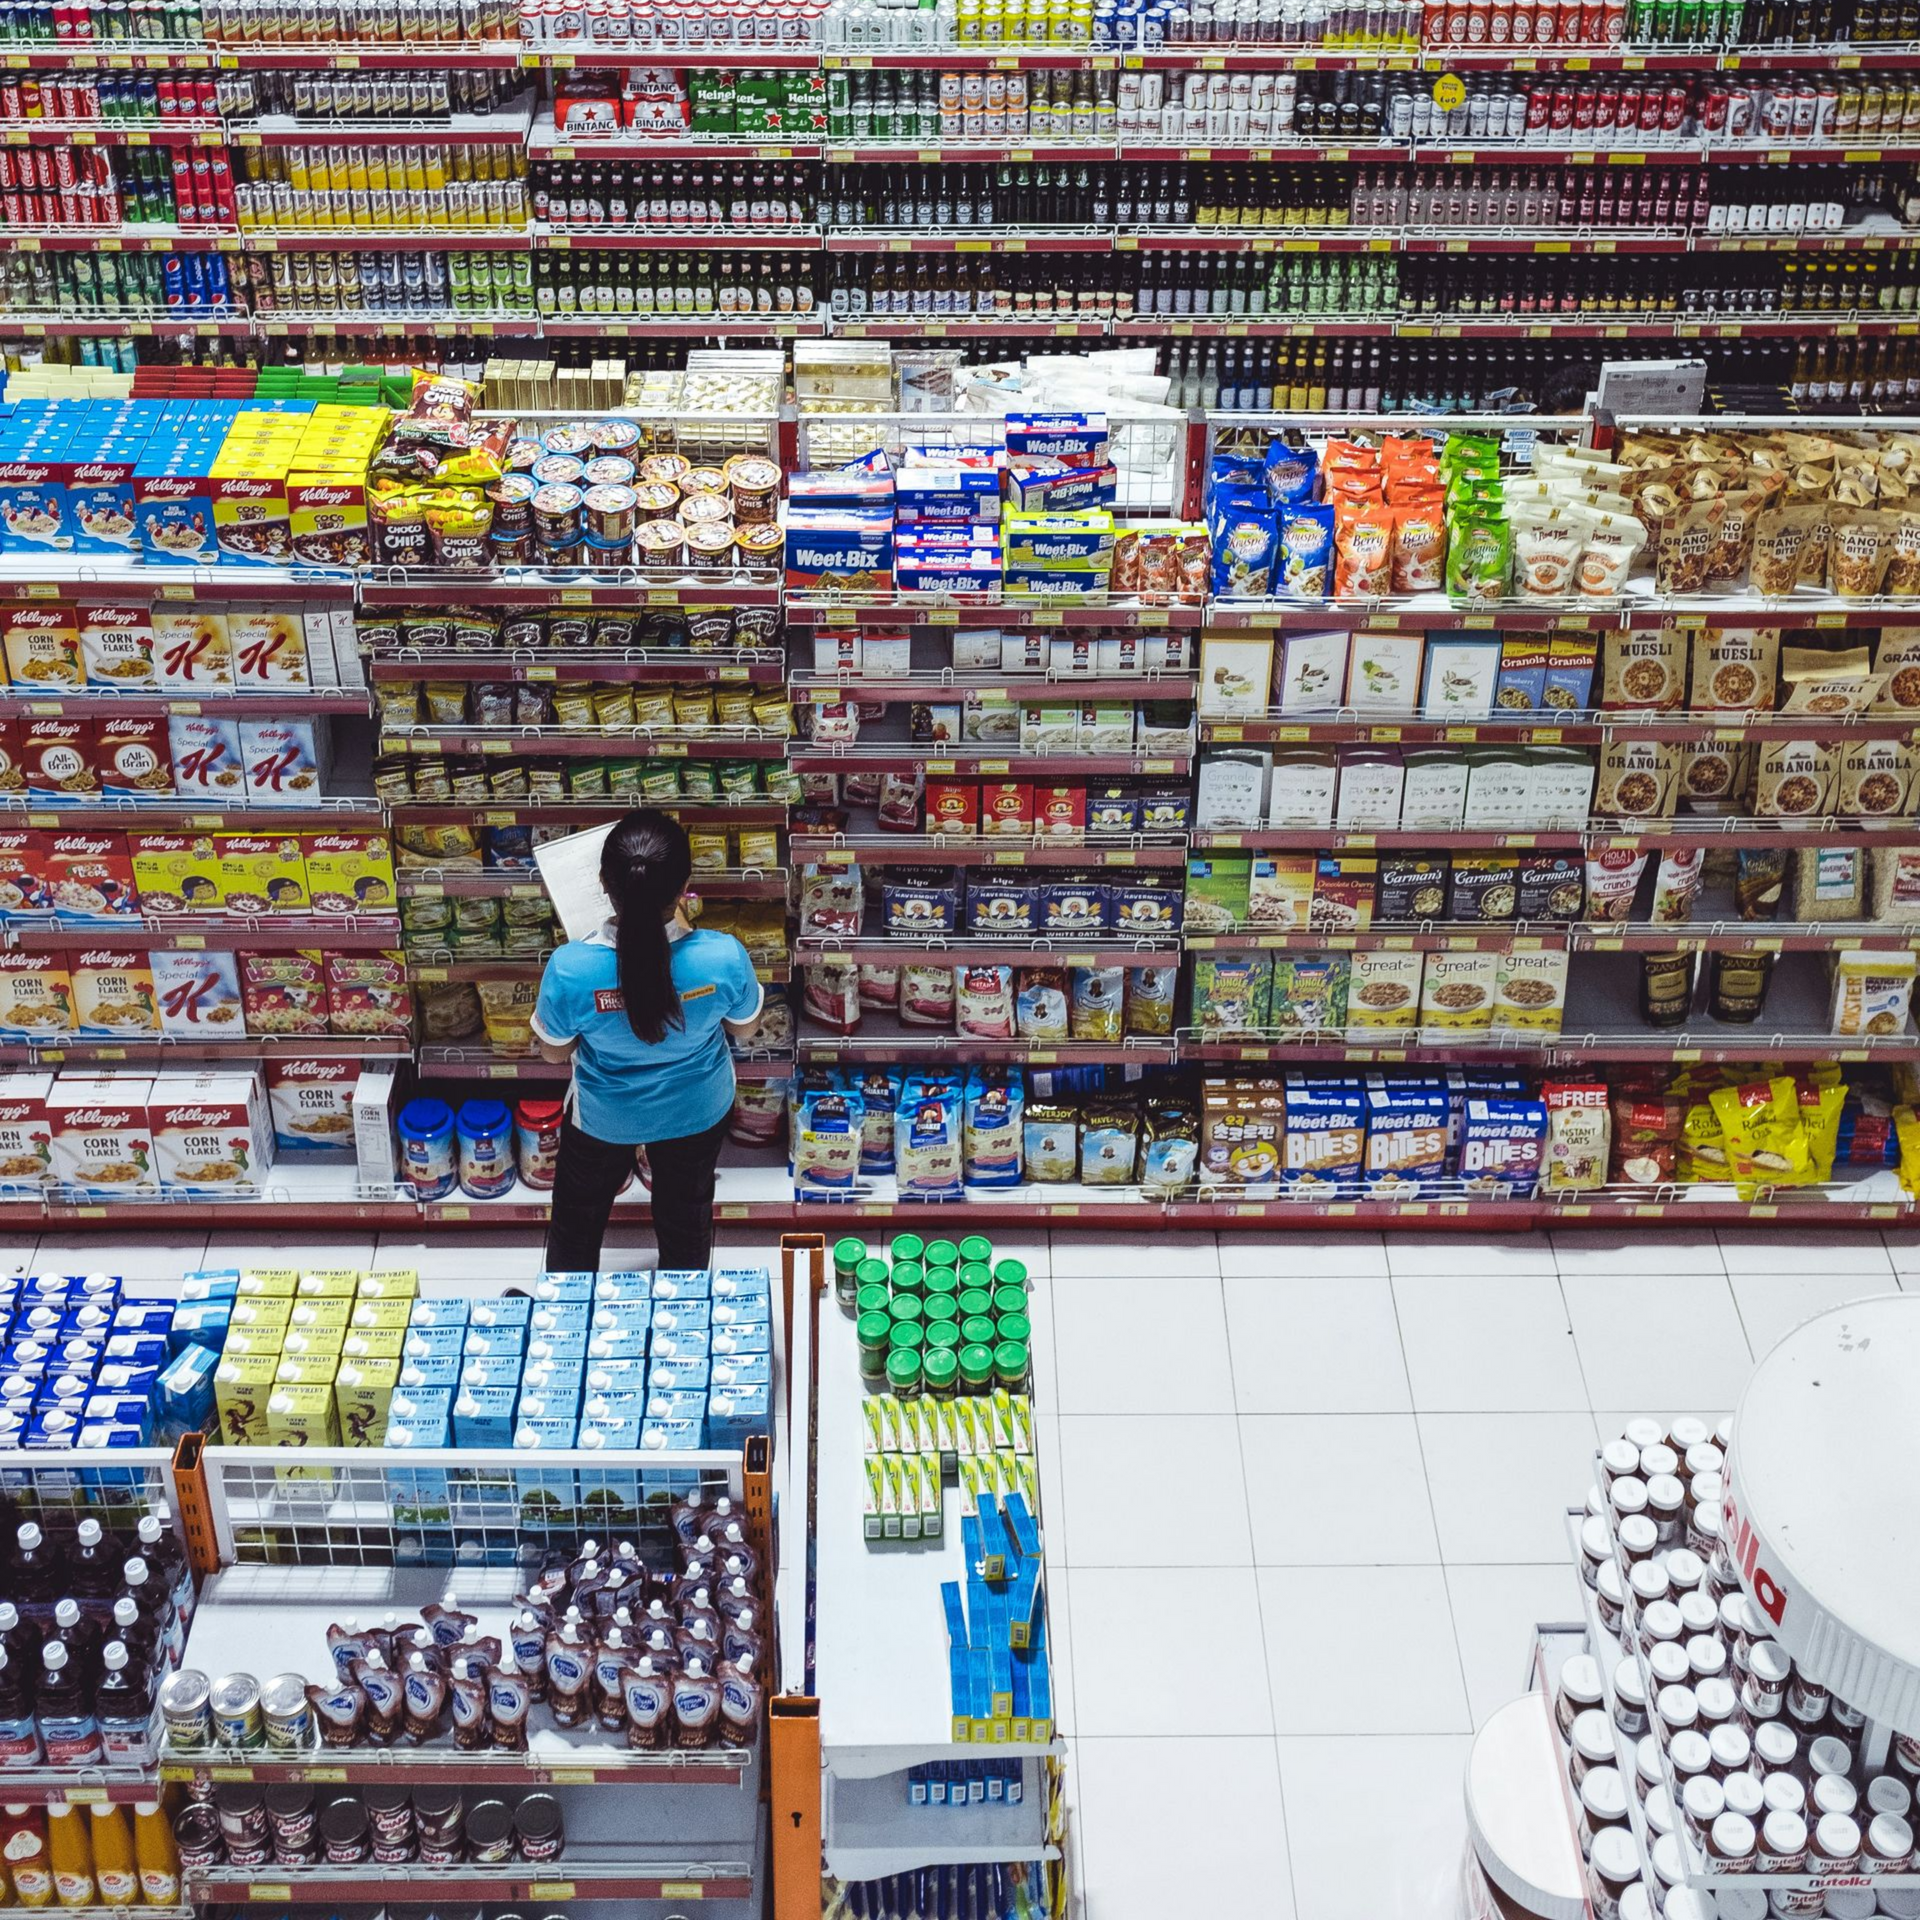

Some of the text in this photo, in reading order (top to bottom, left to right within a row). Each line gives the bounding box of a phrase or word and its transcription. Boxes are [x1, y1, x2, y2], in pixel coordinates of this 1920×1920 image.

[629, 82, 677, 93] BINTANG
[566, 120, 614, 132] BINTANG
[635, 118, 683, 129] BINTANG
[1025, 439, 1089, 455] Weet-Bix
[74, 464, 125, 482] Kellogg's
[144, 478, 196, 495] Kellogg's
[220, 481, 273, 498] Kellogg's
[299, 488, 352, 505] Kellogg's
[923, 505, 972, 517] Weet-Bix
[387, 523, 422, 534] CHOCO
[384, 533, 426, 549] CHIPS
[443, 537, 477, 548] CHOCO
[1228, 534, 1270, 549] Knusper
[1283, 529, 1327, 543] Knusper
[1352, 534, 1384, 550] Berry
[1402, 529, 1436, 545] Berry
[441, 545, 483, 558] CHIPS
[1033, 542, 1088, 557] Weet-Bix
[795, 550, 879, 568] Weet-Bix
[917, 576, 982, 591] Weet-Bix
[1029, 580, 1083, 593] Weet-Bix
[12, 611, 63, 626] Kellogg's
[88, 609, 138, 624] Kellogg's
[28, 635, 54, 644] CORN
[101, 632, 133, 644] CORN
[159, 629, 193, 640] Special
[234, 628, 269, 639] Special
[29, 643, 56, 651] FLAKES
[103, 643, 135, 652] FLAKES
[1620, 644, 1673, 657] MUESLI
[162, 632, 212, 681] K
[238, 632, 288, 681] K
[1548, 655, 1593, 667] Granola
[1709, 648, 1763, 661] MUESLI
[1501, 655, 1546, 669] Granola
[1809, 684, 1864, 694] MUESLI
[31, 722, 81, 736] Kellogg's
[105, 719, 156, 734] Kellogg's
[48, 760, 76, 771] Bran
[52, 754, 72, 764] All-
[121, 758, 150, 769] Bran
[179, 742, 226, 787] K
[1607, 756, 1672, 770] GRANOLA
[1846, 758, 1912, 771] GRANOLA
[251, 747, 300, 792] K
[1765, 760, 1831, 773] GRANOLA
[53, 836, 113, 854] Kellogg's
[139, 836, 185, 851] Kellogg's
[225, 837, 271, 852] Kellogg's
[314, 836, 359, 852] Kellogg's
[693, 837, 724, 847] ENERGEN
[743, 837, 774, 847] ENERGEN
[1383, 869, 1444, 885] Carman's
[1454, 869, 1515, 885] Carman's
[1521, 866, 1582, 884] Carman's
[1316, 879, 1375, 890] Chocolate Cherry
[1603, 879, 1632, 890] crunch
[894, 892, 939, 900] HAVERMOUT
[979, 892, 1024, 900] HAVERMOUT
[1051, 889, 1096, 898] HAVERMOUT
[1123, 893, 1168, 901] HAVERMOUT
[79, 950, 136, 967] Kellogg's
[1504, 955, 1549, 972] great
[157, 970, 199, 980] Special
[1360, 961, 1402, 977] great
[1435, 960, 1479, 977] great
[11, 978, 43, 988] CORN
[96, 977, 127, 987] CORN
[13, 987, 45, 996] FLAKES
[98, 985, 129, 995] FLAKES
[683, 986, 714, 1000] ENERGEN
[162, 972, 220, 1024] K
[281, 1062, 347, 1078] Kellogg's
[299, 1089, 334, 1100] CORN
[1562, 1091, 1607, 1107] FREE
[301, 1098, 335, 1108] FLAKES
[817, 1103, 845, 1113] QUAKER
[979, 1103, 1007, 1113] QUAKER
[63, 1110, 131, 1128] Kellogg's
[164, 1109, 232, 1126] Kellogg's
[1288, 1114, 1356, 1130] Weet-Bix
[1371, 1113, 1440, 1130] Weet-Bix
[1634, 1113, 1664, 1122] LOWAN
[915, 1122, 944, 1132] QUAKER
[1467, 1125, 1537, 1138] Weet-Bix
[1559, 1127, 1596, 1138] INSTANT
[83, 1137, 119, 1148] CORN
[183, 1136, 219, 1147] CORN
[1566, 1136, 1590, 1145] OATS
[85, 1147, 121, 1157] FLAKES
[185, 1146, 222, 1156] FLAKES
[1808, 1877, 1872, 1888] nutella
